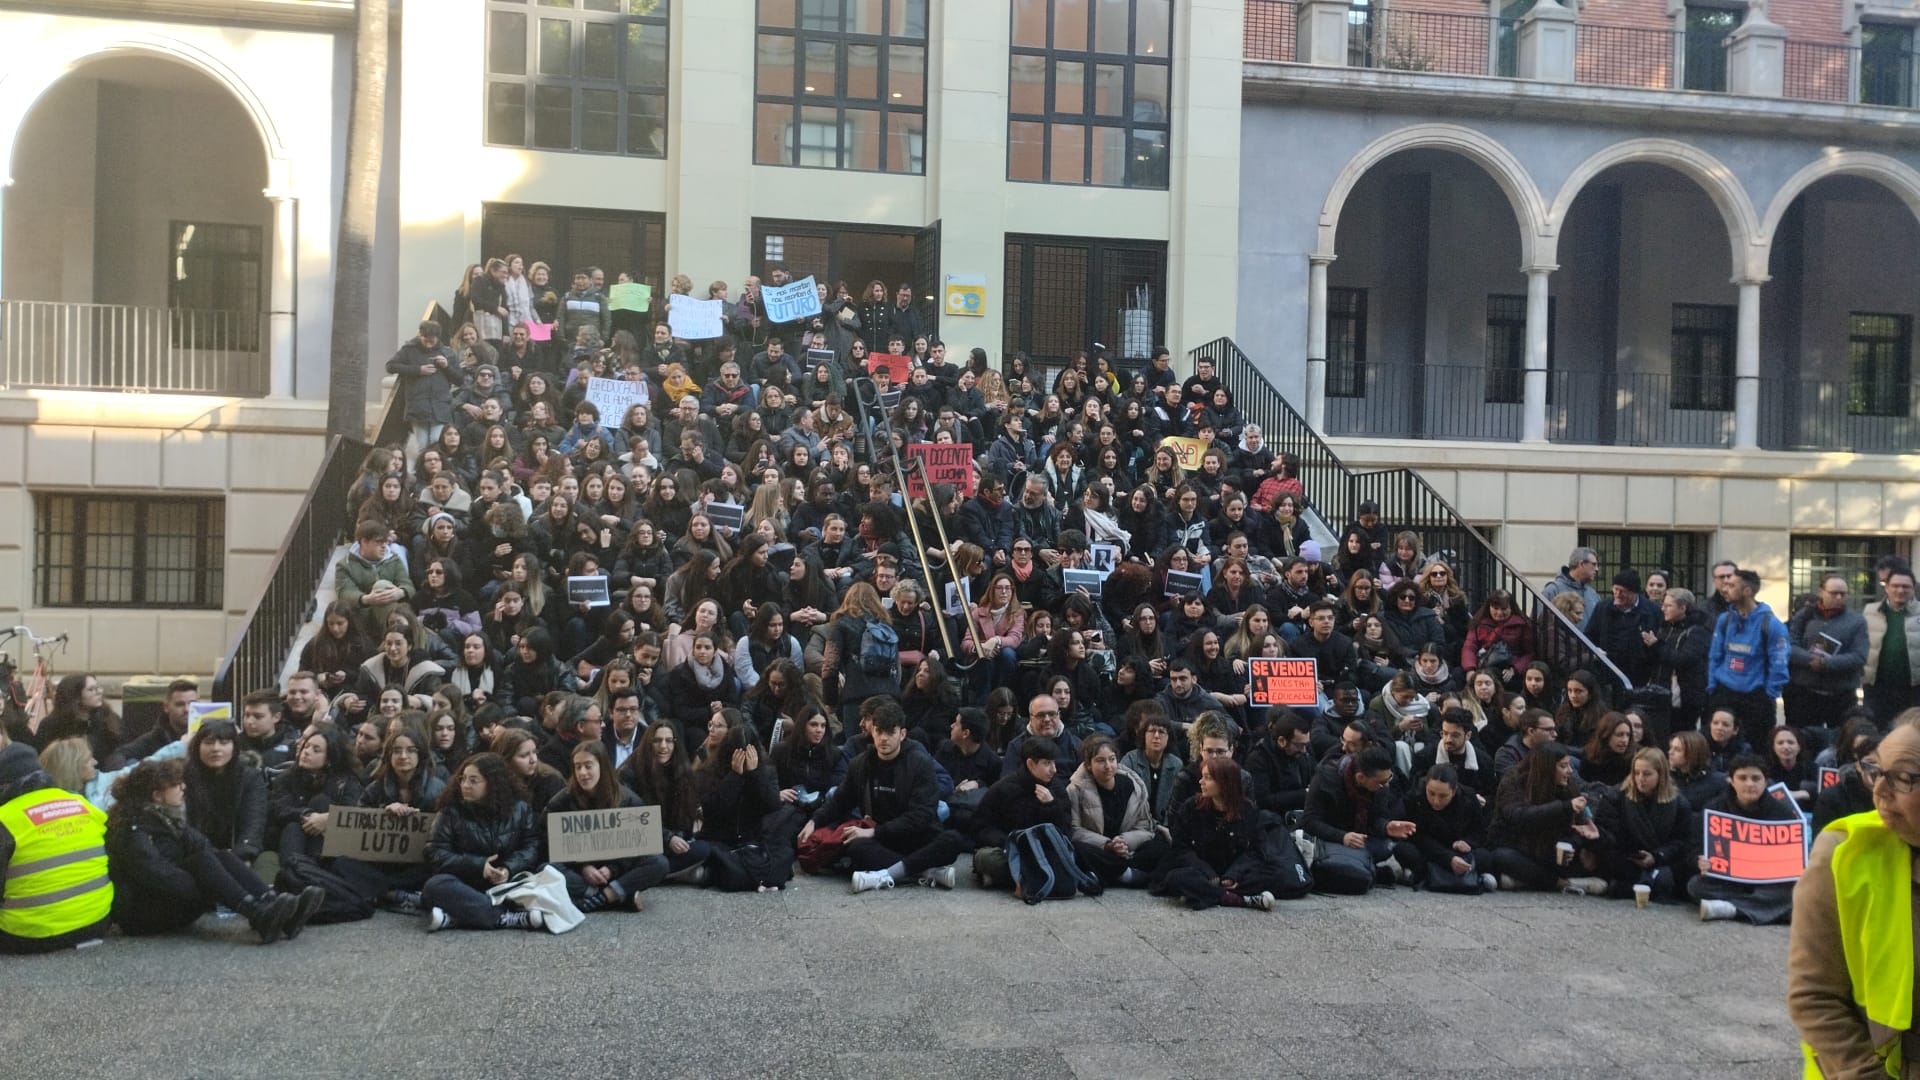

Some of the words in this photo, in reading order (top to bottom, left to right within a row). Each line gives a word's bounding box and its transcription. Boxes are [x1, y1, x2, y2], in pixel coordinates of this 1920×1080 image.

[767, 294, 817, 320] FUTURO
[613, 395, 633, 406] ALMA
[930, 447, 971, 466] DOCENTE
[935, 468, 967, 480] LUCHA
[1252, 661, 1269, 676] SE
[1270, 661, 1314, 676] VENDE
[336, 811, 377, 830] LETRAS
[411, 816, 428, 833] DE
[1709, 815, 1733, 839] SE
[1736, 820, 1802, 844] VENDE
[360, 832, 410, 855] LUTO
